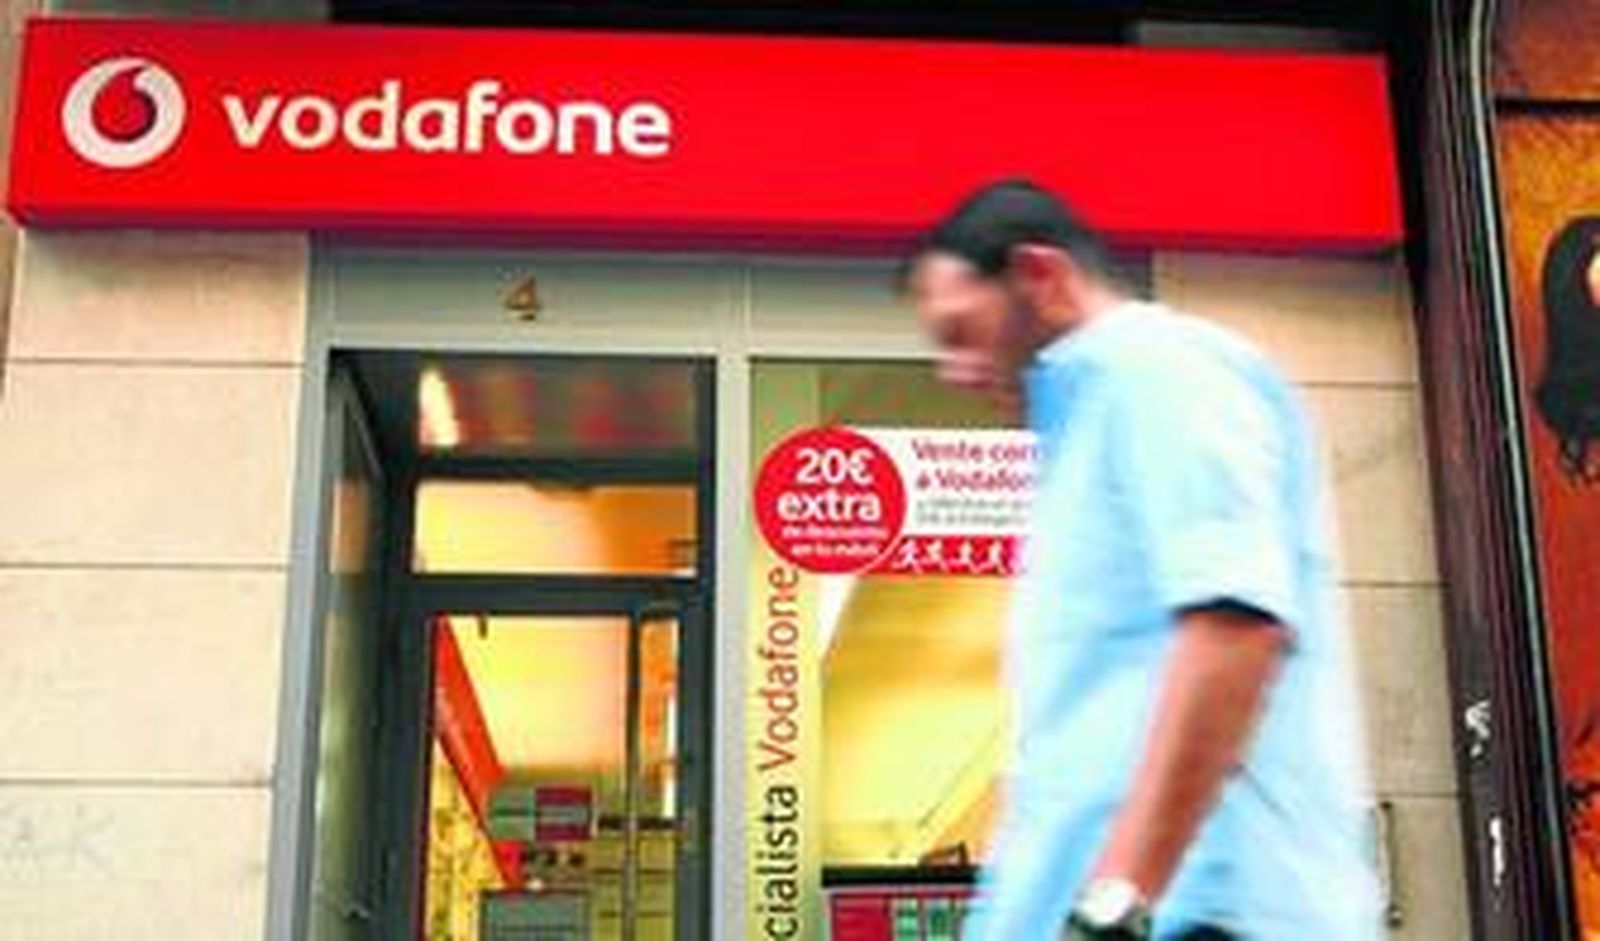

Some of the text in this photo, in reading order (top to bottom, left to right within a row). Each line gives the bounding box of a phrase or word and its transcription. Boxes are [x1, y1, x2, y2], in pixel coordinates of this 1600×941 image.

[223, 80, 672, 158] vodafone
[504, 276, 543, 321] 4
[796, 447, 875, 485] 20€
[777, 489, 881, 522] extra
[757, 566, 799, 772] Vodafone
